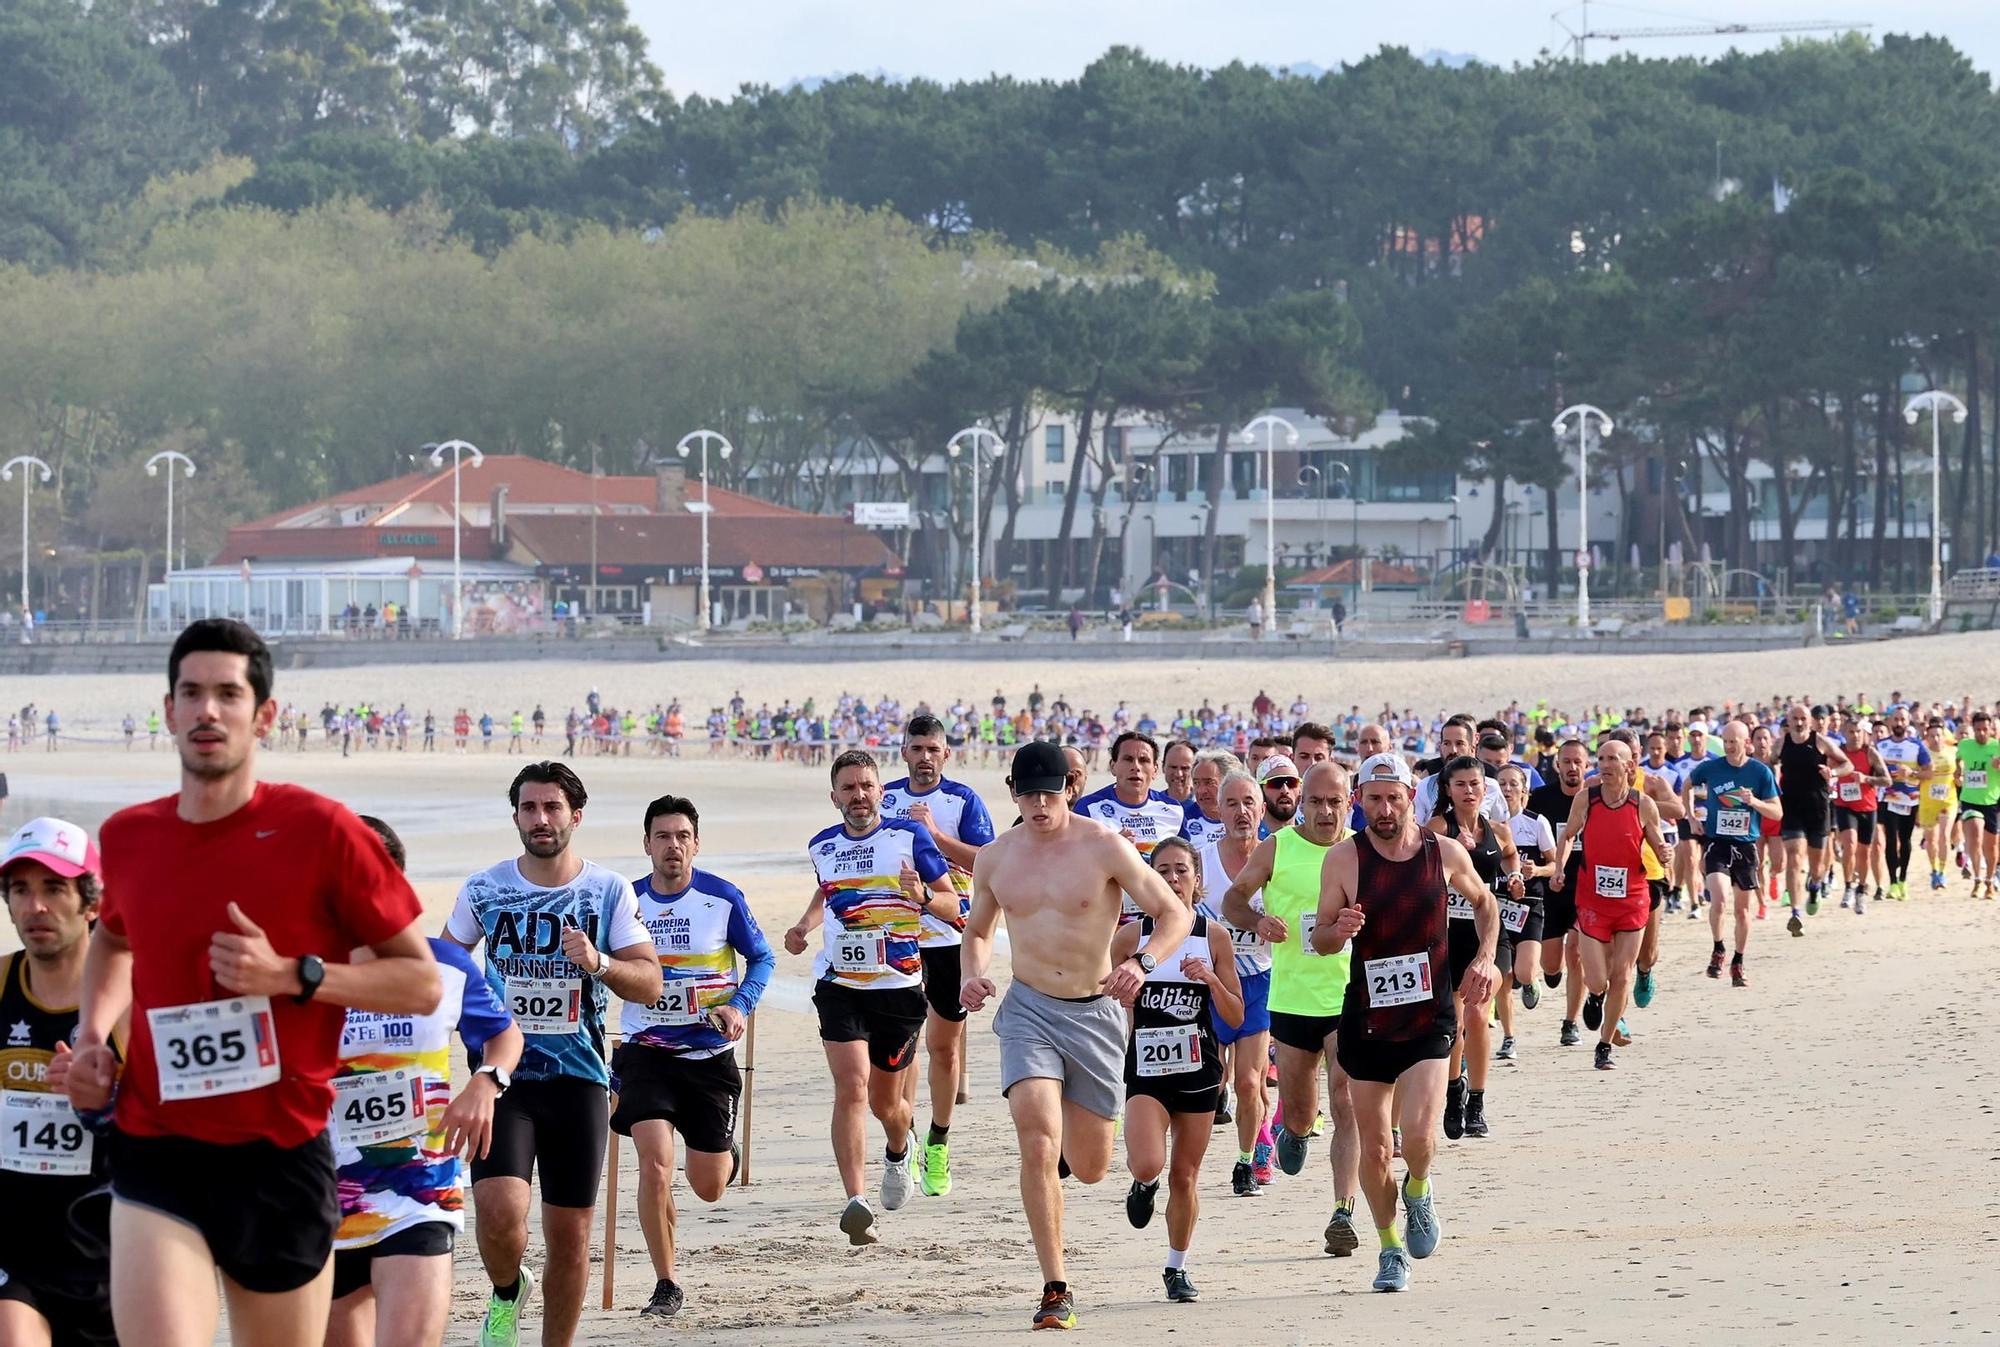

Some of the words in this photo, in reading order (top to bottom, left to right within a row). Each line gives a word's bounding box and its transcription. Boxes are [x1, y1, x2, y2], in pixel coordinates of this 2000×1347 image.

[1721, 819, 1742, 828] 342
[856, 859, 873, 870] 100
[1599, 876, 1624, 888] 254
[491, 911, 599, 955] ADN
[645, 918, 690, 930] CARREIRA
[670, 934, 690, 945] 100
[842, 946, 866, 961] 56
[1373, 971, 1417, 994] 213
[513, 995, 563, 1017] 302
[1142, 987, 1202, 1010] delikia
[1175, 1008, 1193, 1017] fresh
[382, 1022, 413, 1039] 100
[168, 1030, 246, 1070] 365
[1143, 1042, 1183, 1063] 201
[344, 1091, 406, 1124] 465
[13, 1120, 83, 1152] 149
